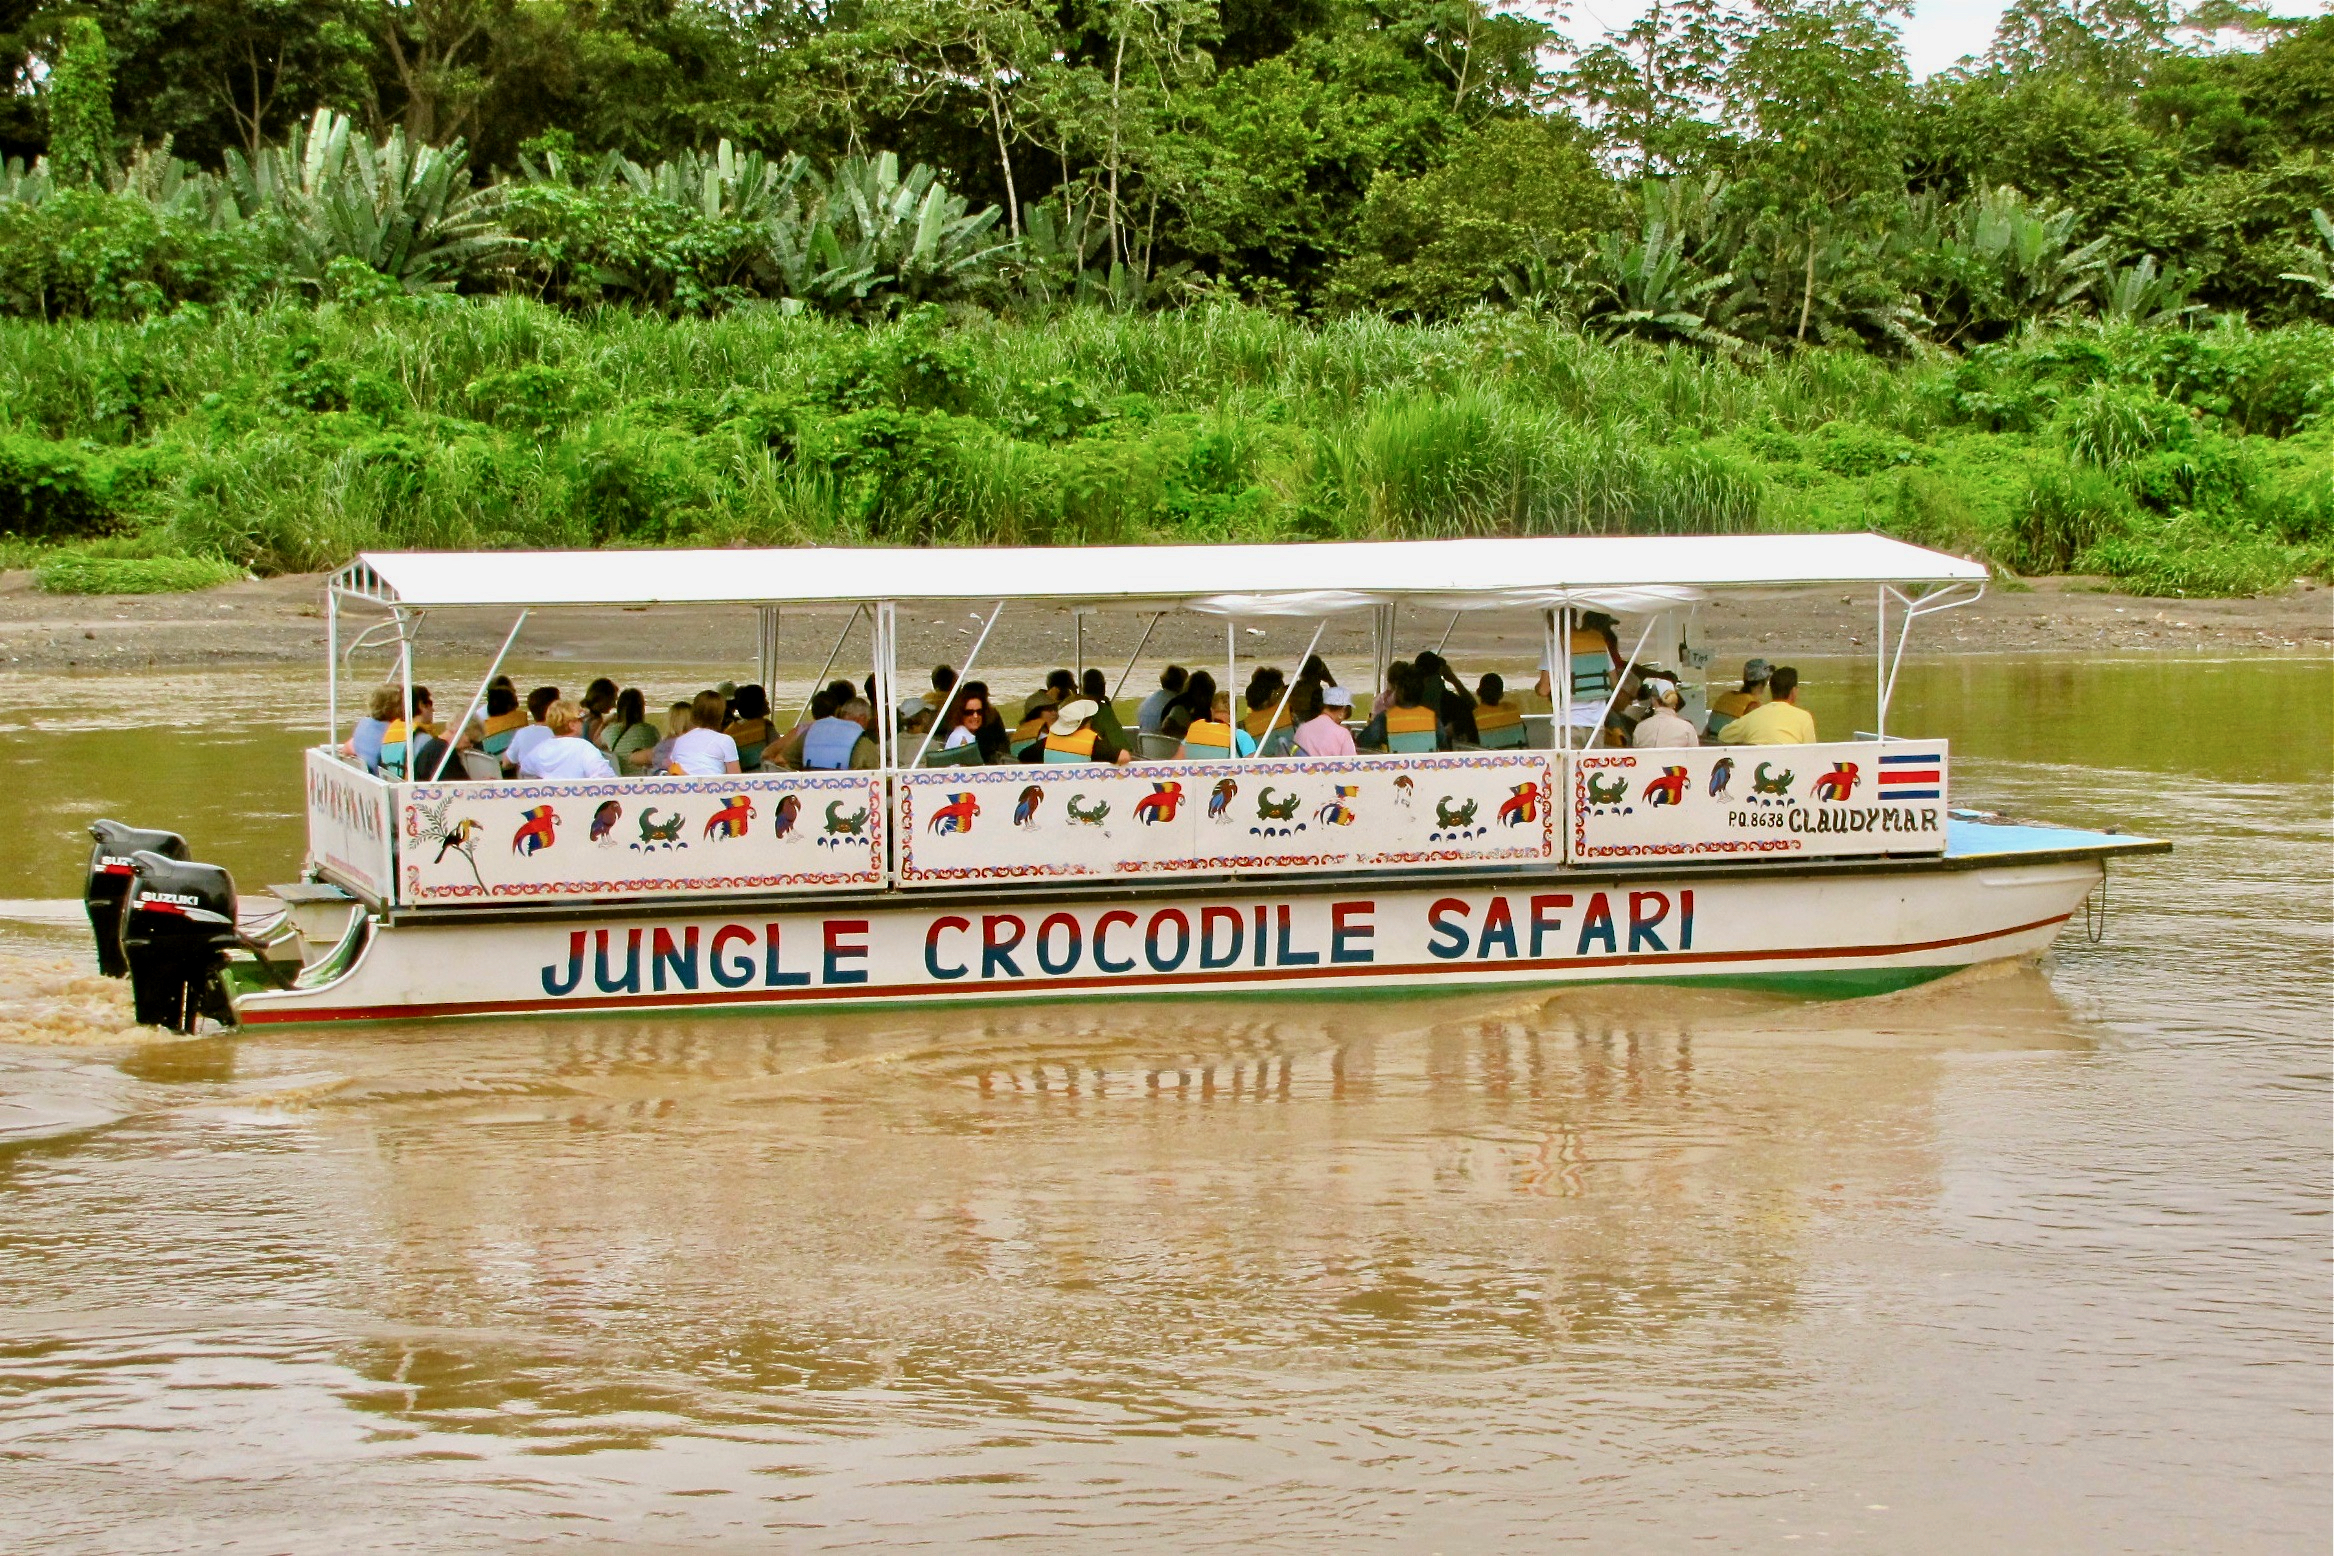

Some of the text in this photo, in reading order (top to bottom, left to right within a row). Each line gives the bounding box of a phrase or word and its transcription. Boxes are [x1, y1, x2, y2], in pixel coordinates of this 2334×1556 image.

[1788, 808, 1939, 834] CLAUDYMAR
[101, 855, 135, 867] SUZ
[140, 891, 199, 906] SUZUKI
[541, 890, 1694, 996] JUNGLE CROCODILE SAFARI
